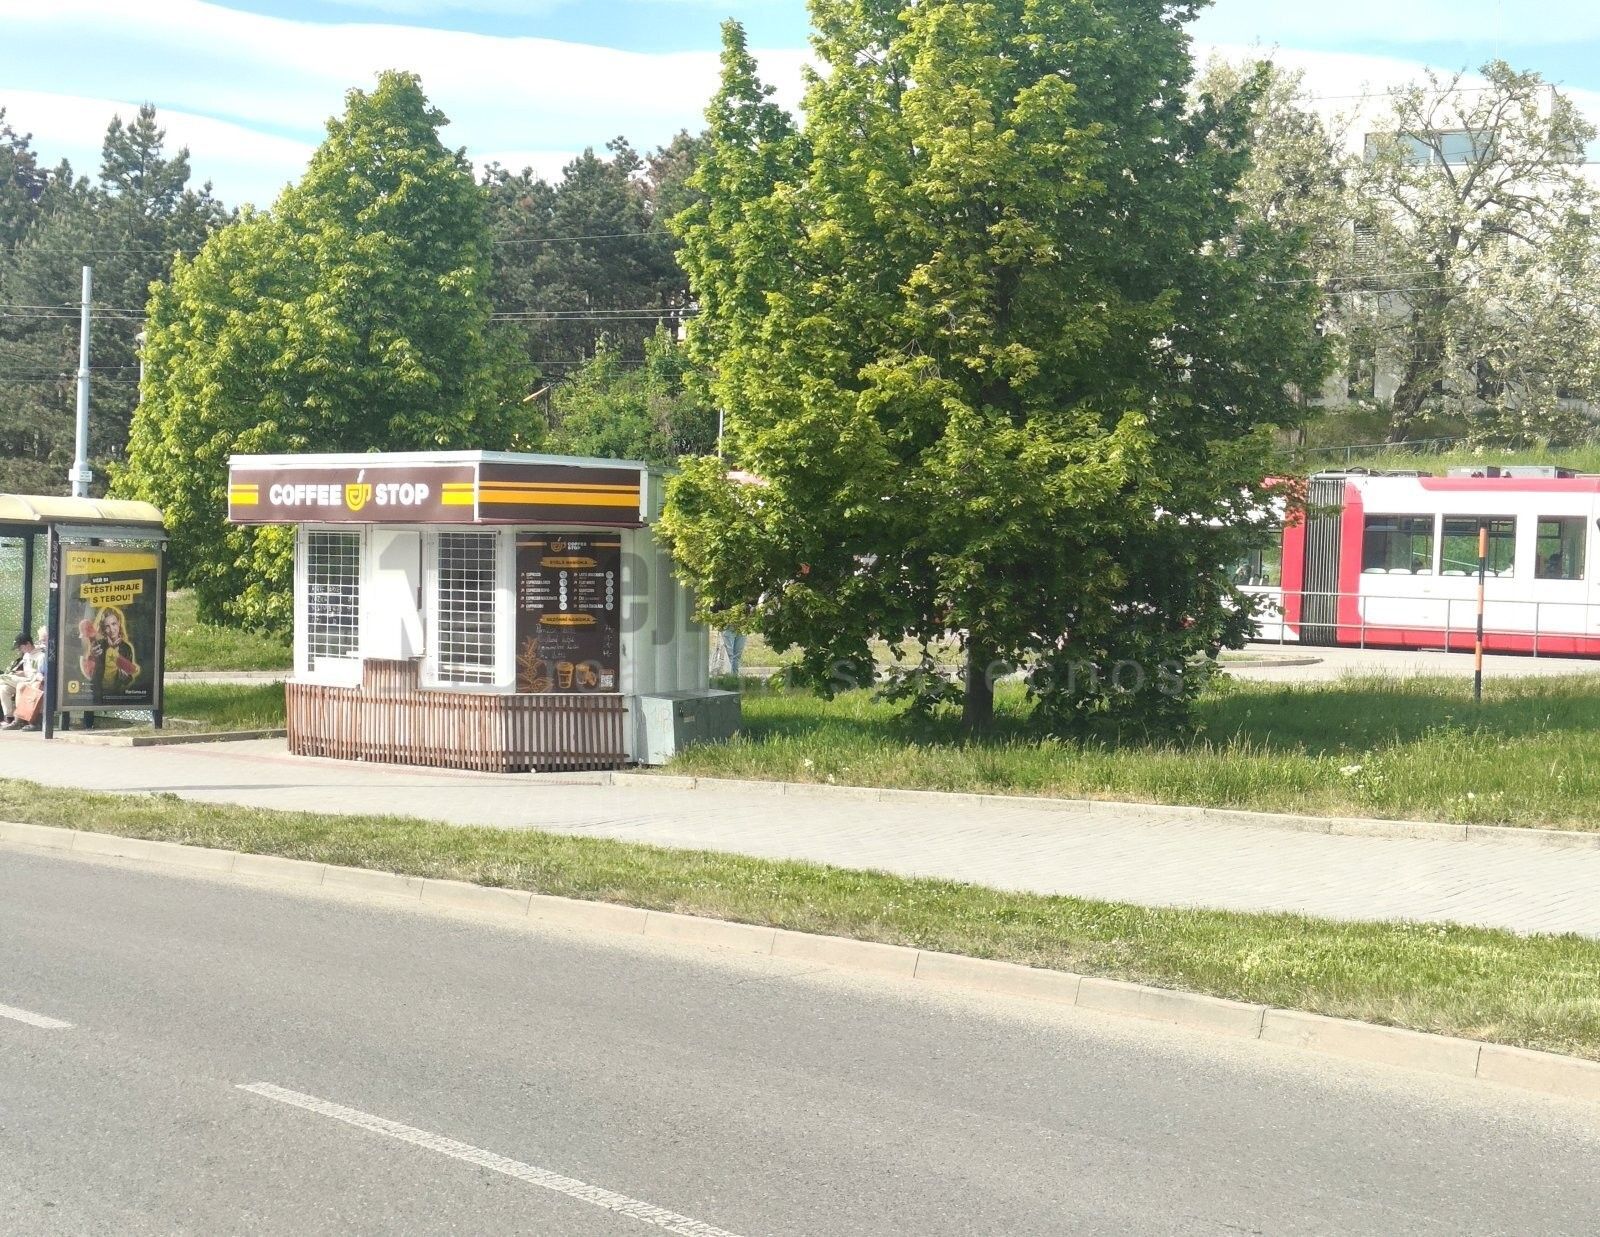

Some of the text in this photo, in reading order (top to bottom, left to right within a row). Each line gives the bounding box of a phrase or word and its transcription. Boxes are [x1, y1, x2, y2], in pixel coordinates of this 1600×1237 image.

[269, 482, 429, 506] COFFEE STOP
[71, 556, 106, 564] FORTUNA
[114, 583, 140, 592] HRAJE
[92, 593, 131, 604] S TEBOU!
